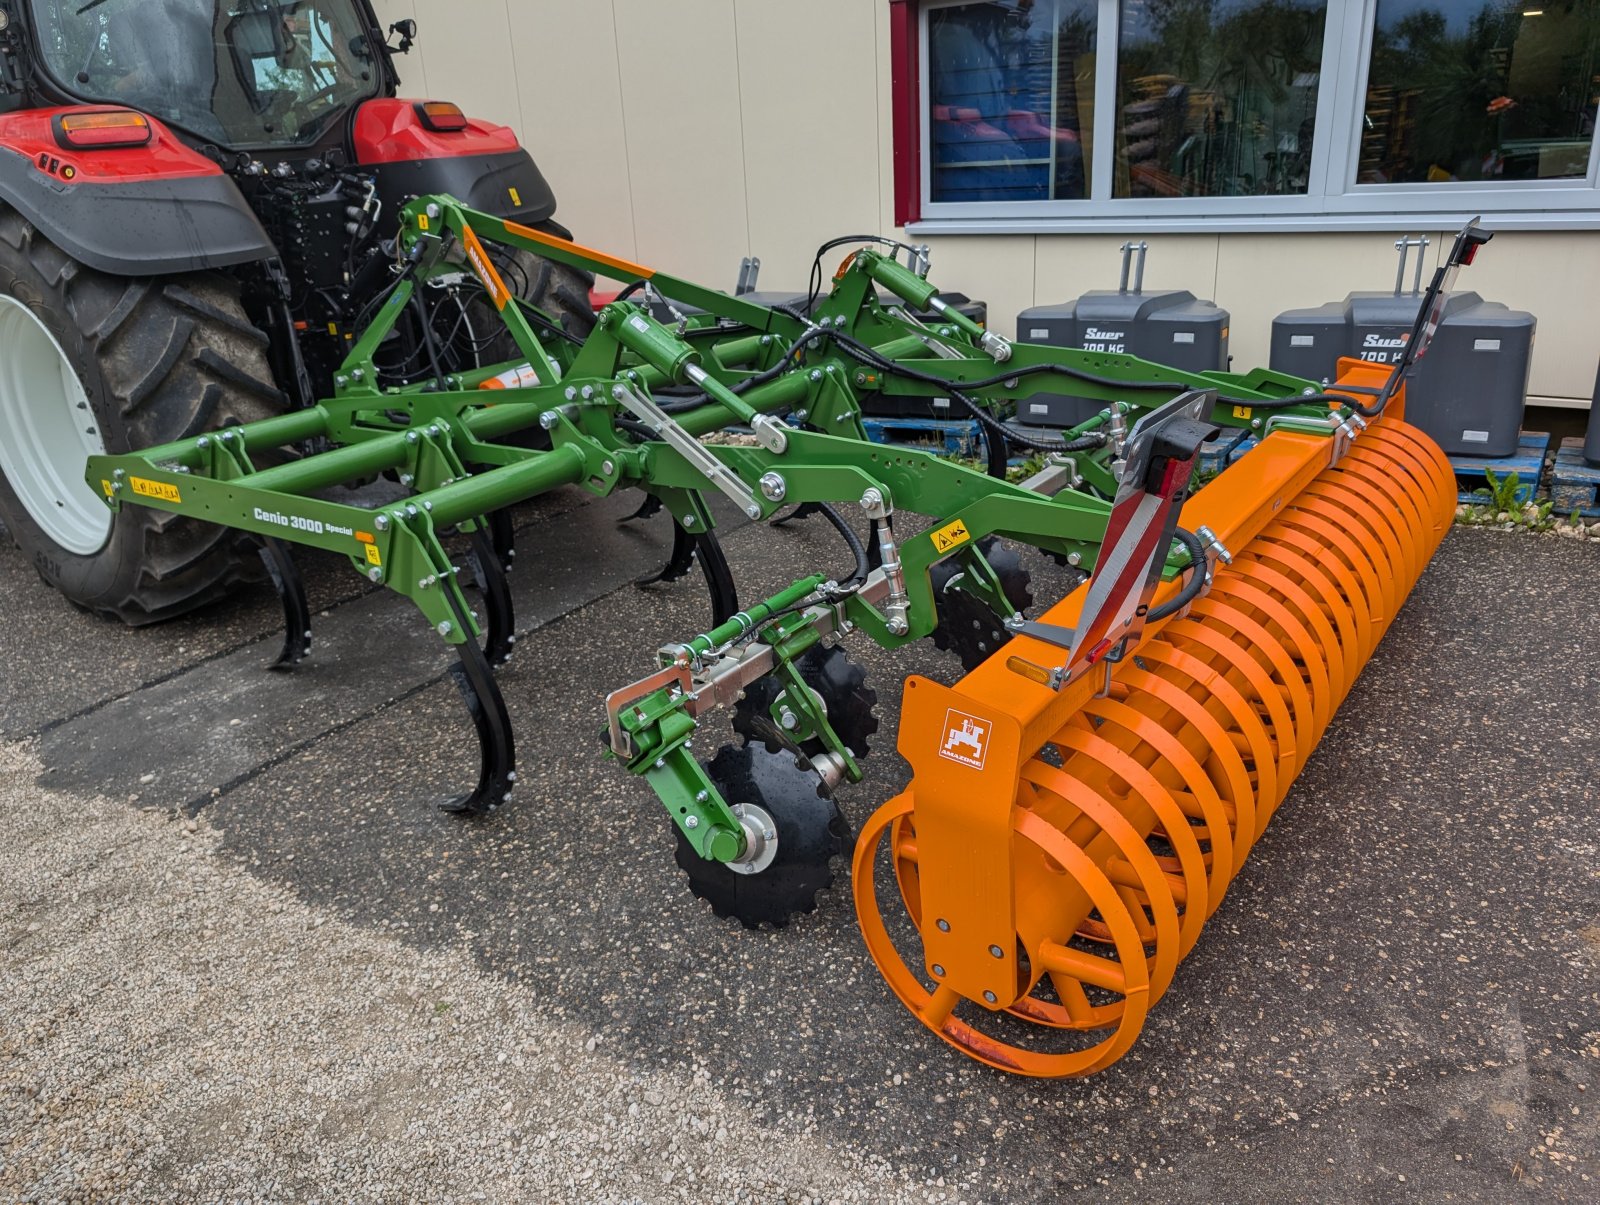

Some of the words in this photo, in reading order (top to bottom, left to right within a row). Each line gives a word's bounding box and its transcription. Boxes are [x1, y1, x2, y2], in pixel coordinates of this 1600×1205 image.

[469, 246, 498, 299] AMAZONE
[1084, 327, 1125, 340] Suer
[1083, 343, 1105, 352] 700
[1108, 344, 1125, 354] KG
[1360, 351, 1388, 362] 700
[1391, 352, 1403, 363] K
[253, 507, 289, 526] Cenio
[290, 515, 323, 534] 3000
[325, 523, 353, 536] Special
[941, 749, 982, 767] AMAZONE
